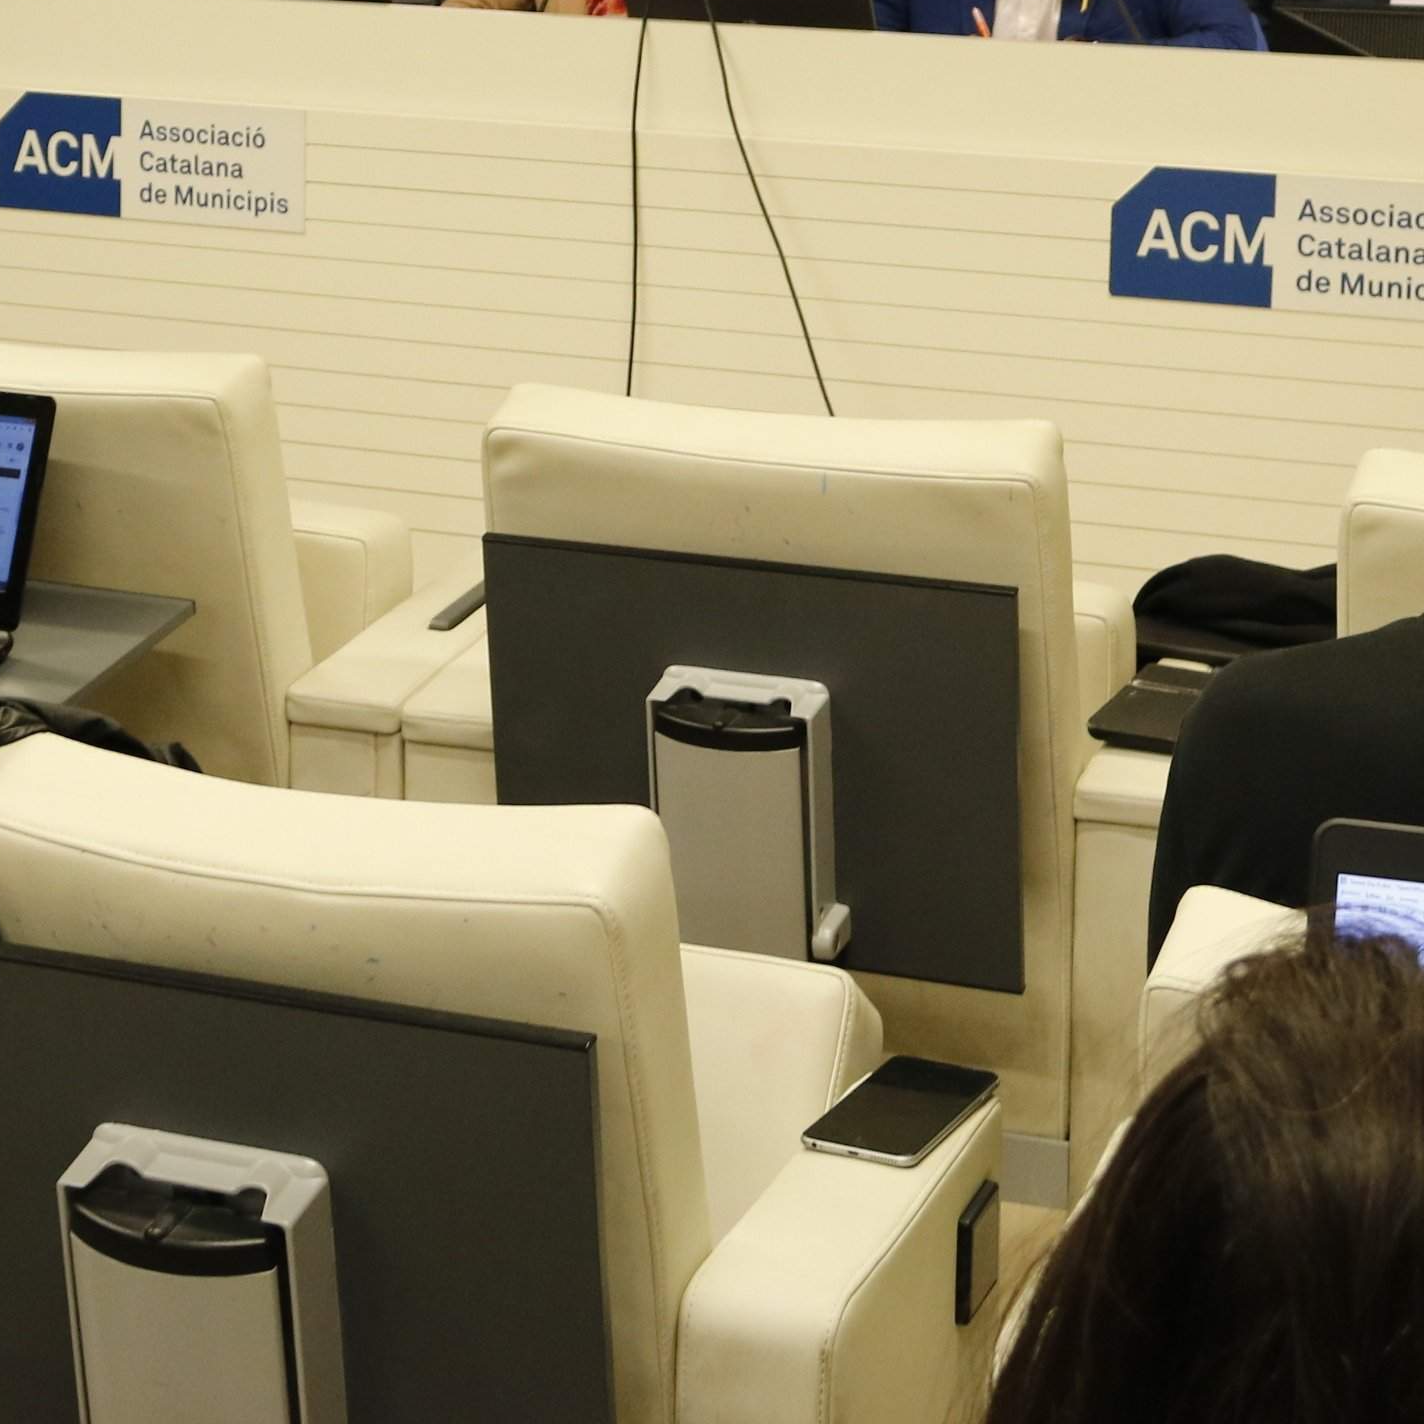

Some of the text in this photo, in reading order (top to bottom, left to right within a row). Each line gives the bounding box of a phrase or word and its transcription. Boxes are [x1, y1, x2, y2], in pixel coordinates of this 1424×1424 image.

[139, 119, 266, 149] Associació
[13, 129, 121, 181] ACM
[139, 151, 243, 180] Catalana
[140, 183, 289, 217] de Municipis
[1136, 208, 1275, 268] ACM
[1295, 269, 1331, 294] de
